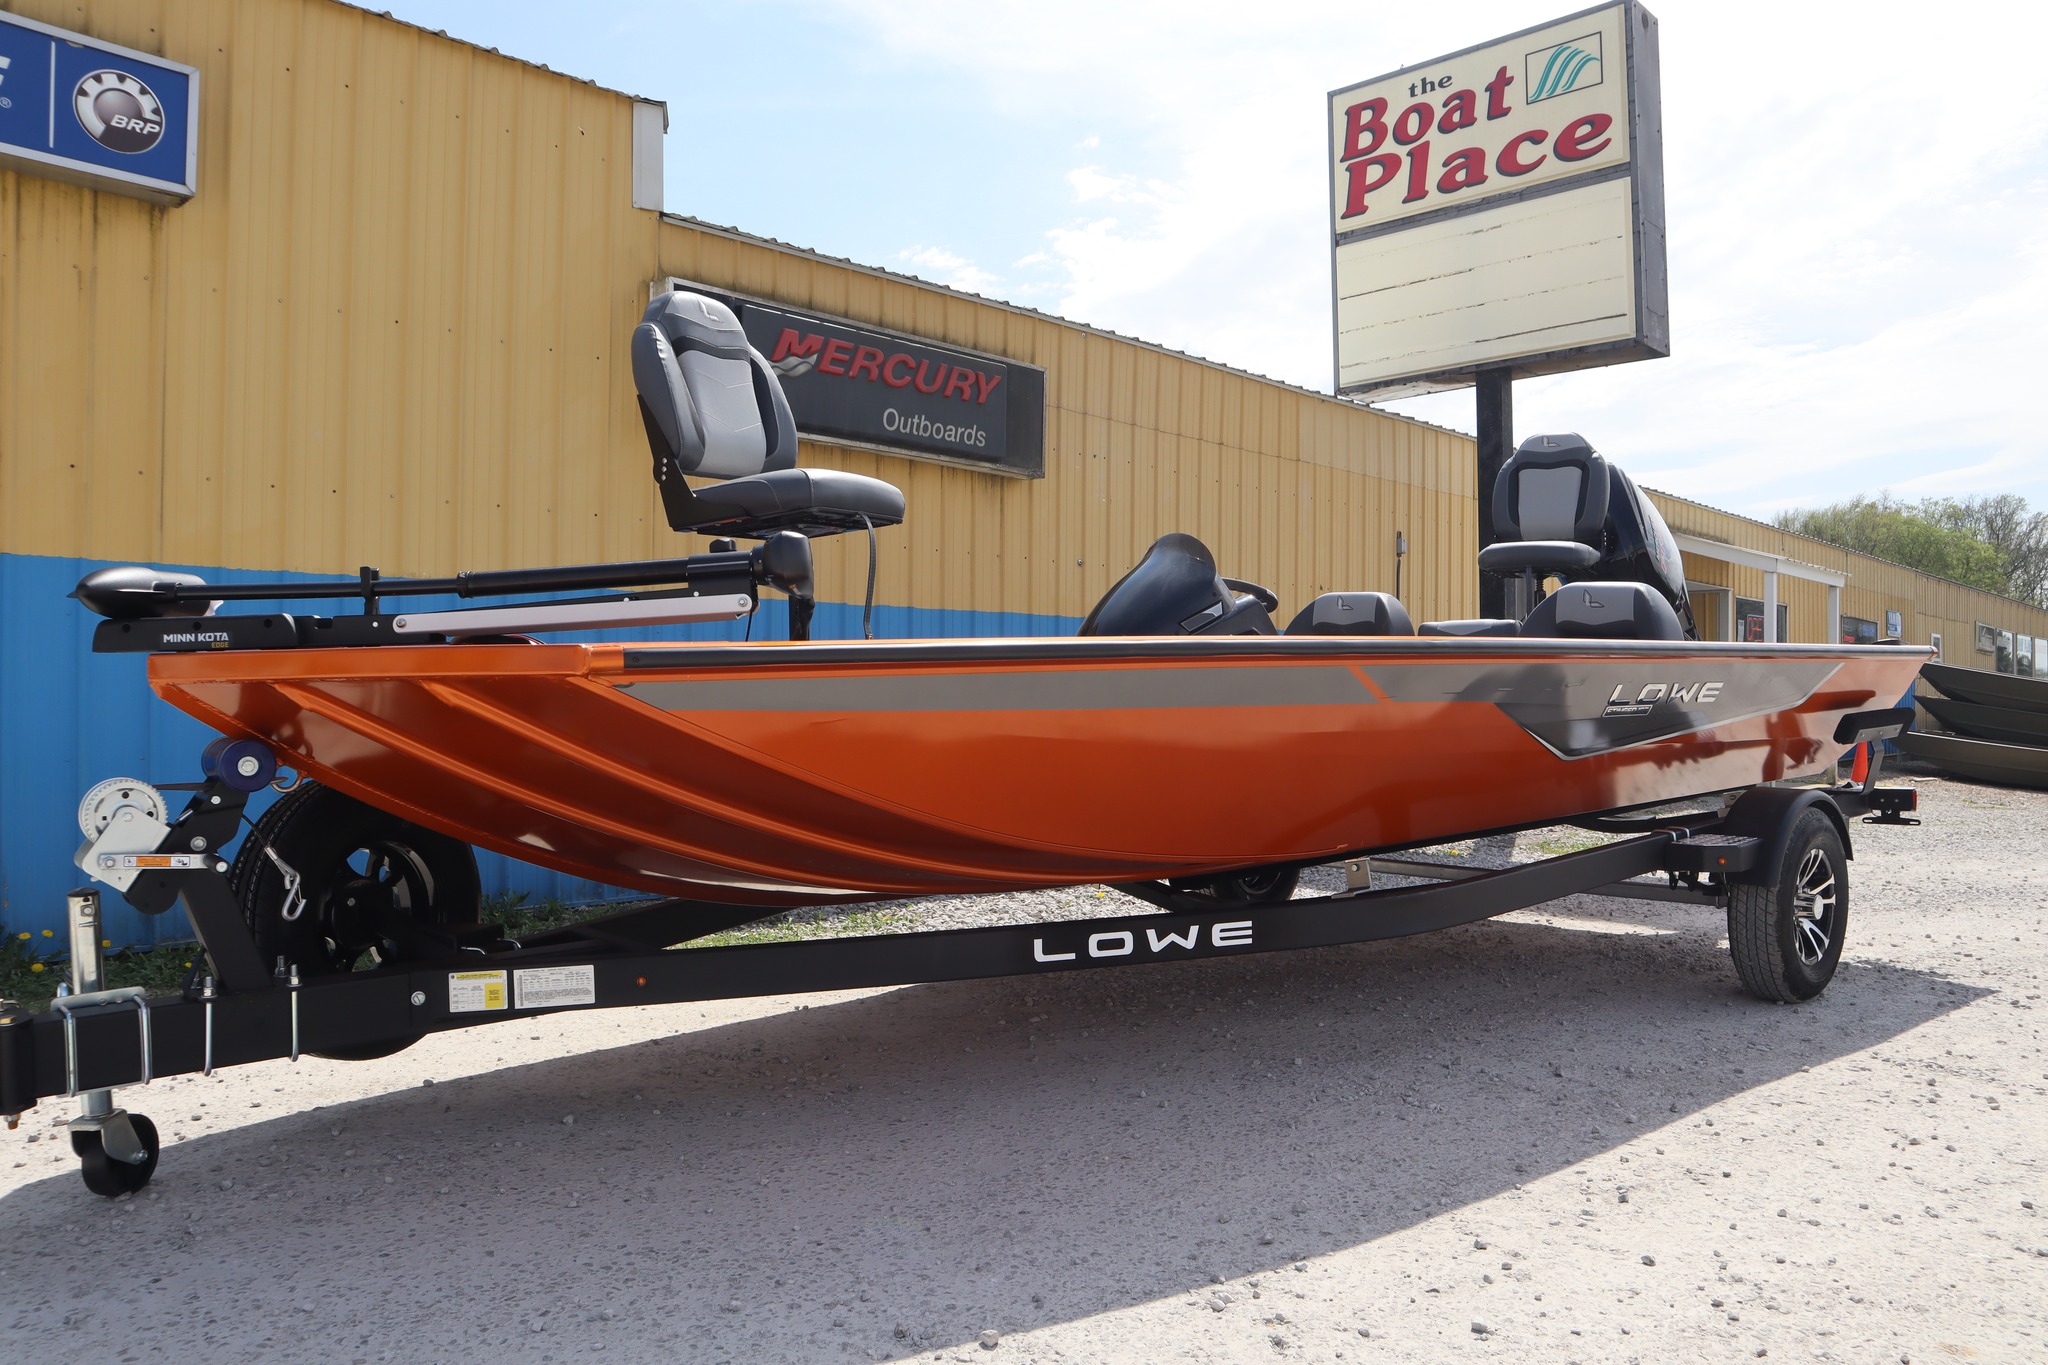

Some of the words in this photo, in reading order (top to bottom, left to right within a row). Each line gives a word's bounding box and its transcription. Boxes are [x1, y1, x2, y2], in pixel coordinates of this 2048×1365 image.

[1408, 75, 1453, 98] the
[110, 114, 160, 135] BRP
[1340, 65, 1514, 163] Boat
[1340, 113, 1613, 219] Place
[771, 328, 1002, 405] MERCURY
[882, 407, 986, 447] Outboards
[163, 633, 196, 643] MINN
[197, 632, 229, 642] KOTA
[1608, 682, 1724, 705] LOWE
[1033, 920, 1253, 963] LOWE
